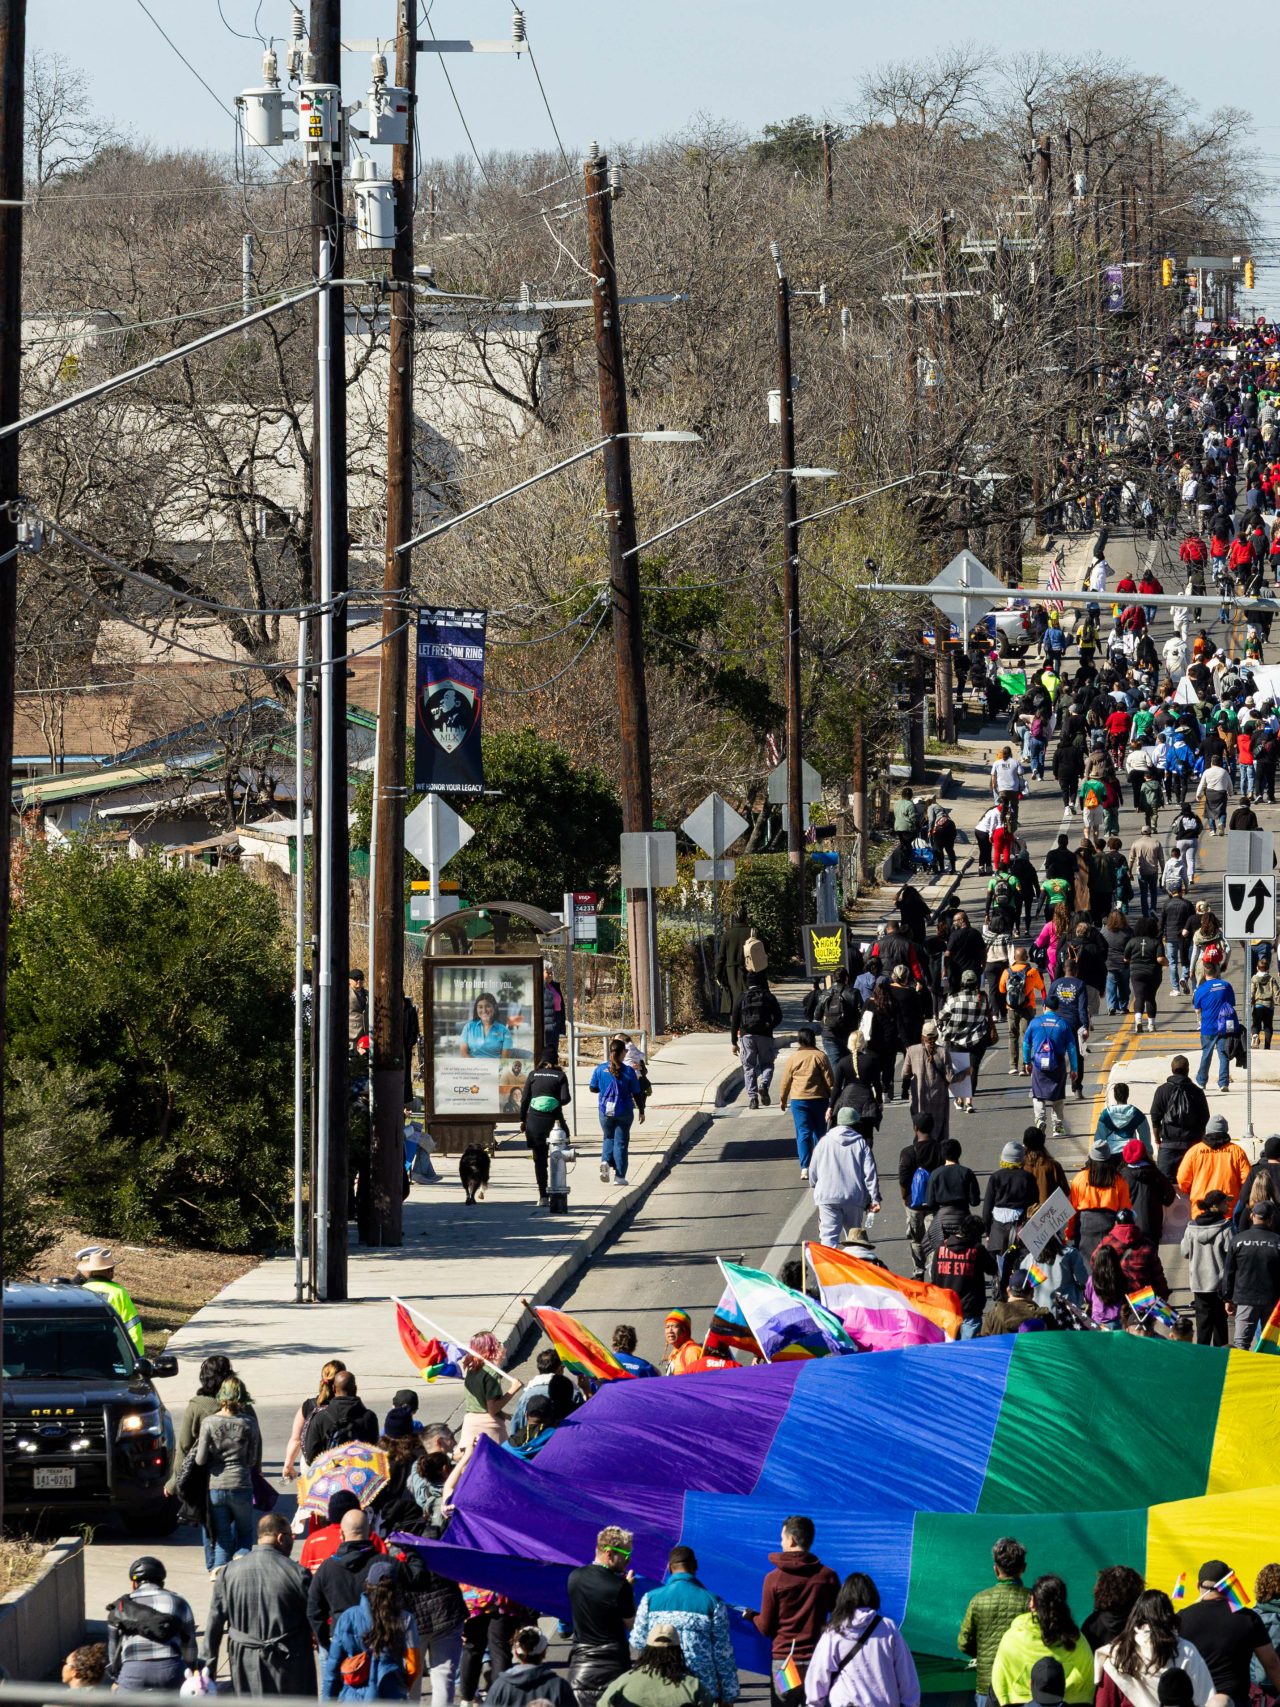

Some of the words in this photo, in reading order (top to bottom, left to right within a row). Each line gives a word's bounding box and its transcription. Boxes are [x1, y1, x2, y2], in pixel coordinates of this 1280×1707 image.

[420, 609, 485, 629] MLK
[418, 644, 431, 656] LET
[432, 645, 464, 658] FREEDOM
[465, 646, 483, 659] RING
[441, 734, 459, 742] MLK
[426, 783, 446, 791] HONOR
[446, 783, 461, 792] YOUR
[461, 784, 483, 792] LEGACY
[474, 979, 488, 989] here
[489, 979, 499, 989] for
[453, 1085, 470, 1095] cps
[937, 1261, 951, 1275] THE
[706, 1359, 726, 1368] Staff
